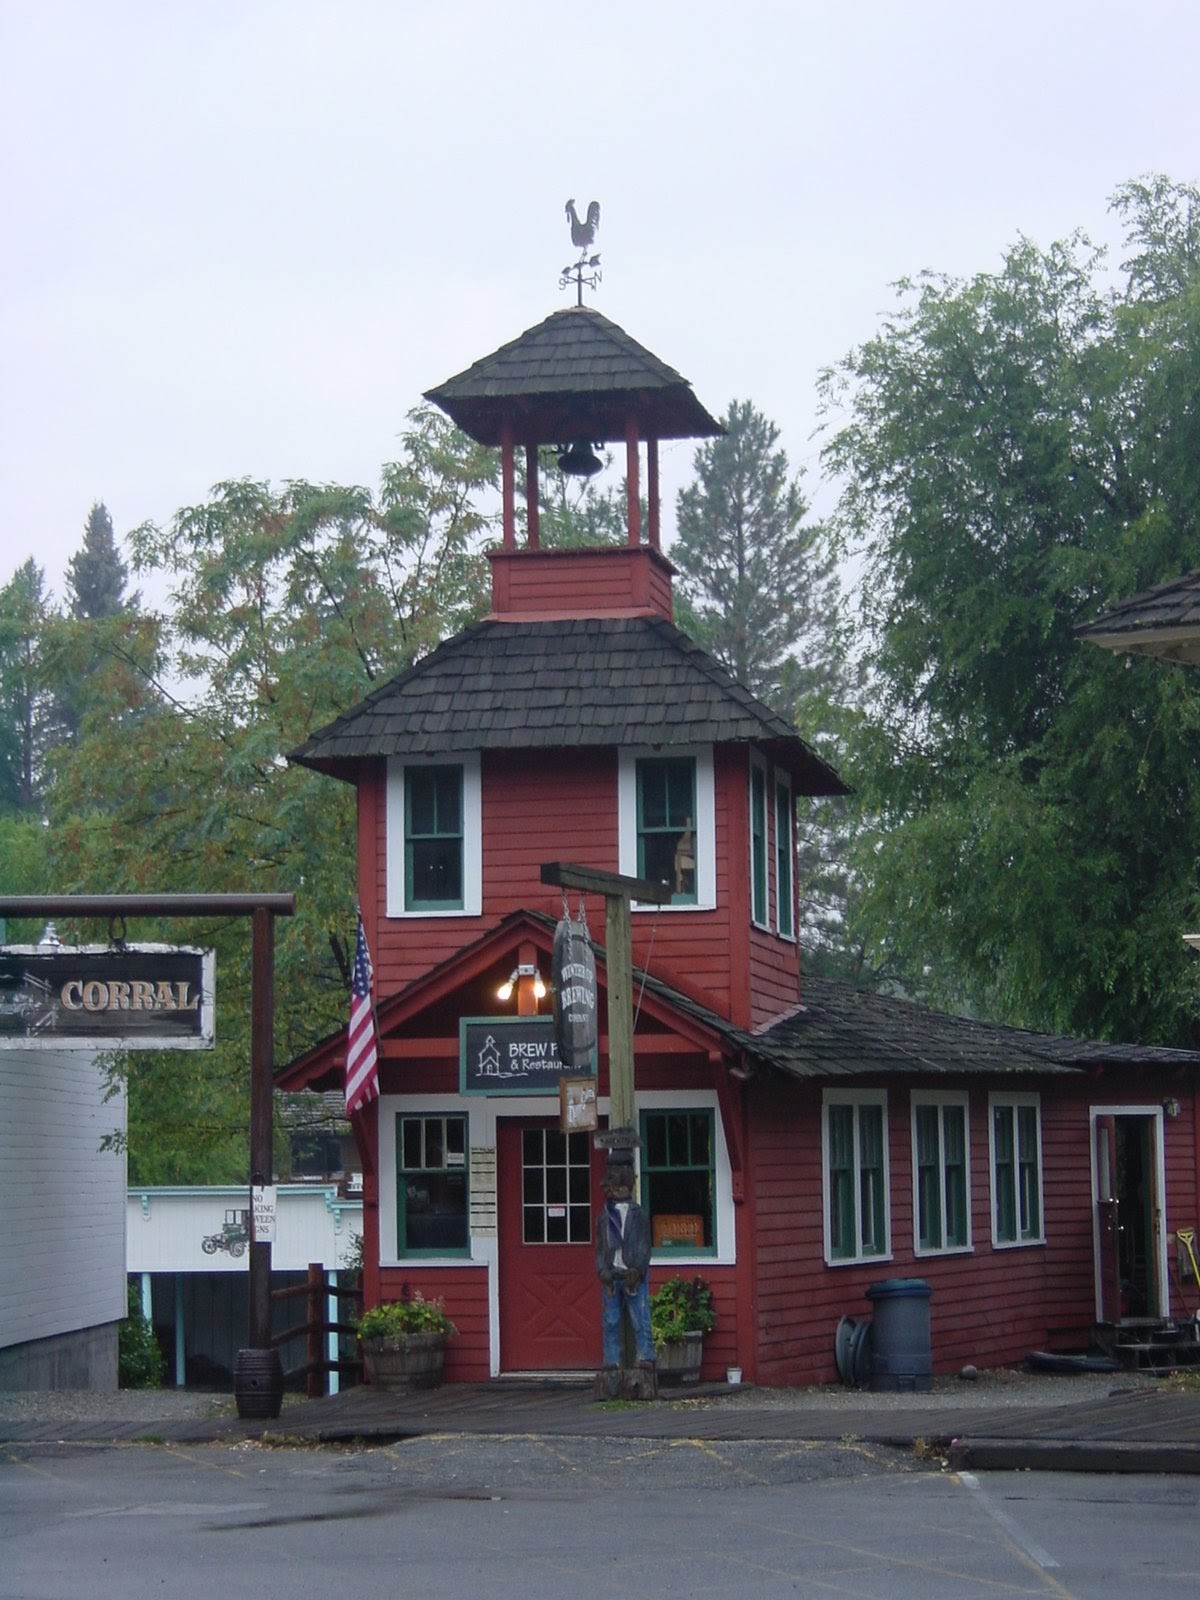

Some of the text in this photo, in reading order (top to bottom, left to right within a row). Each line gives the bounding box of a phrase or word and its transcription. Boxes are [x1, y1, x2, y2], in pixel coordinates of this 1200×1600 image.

[61, 980, 200, 1011] CORRAL
[561, 986, 595, 1010] BREWING
[509, 1042, 547, 1057] BREW
[510, 1058, 582, 1071] & Restaur
[254, 1204, 274, 1213] KING
